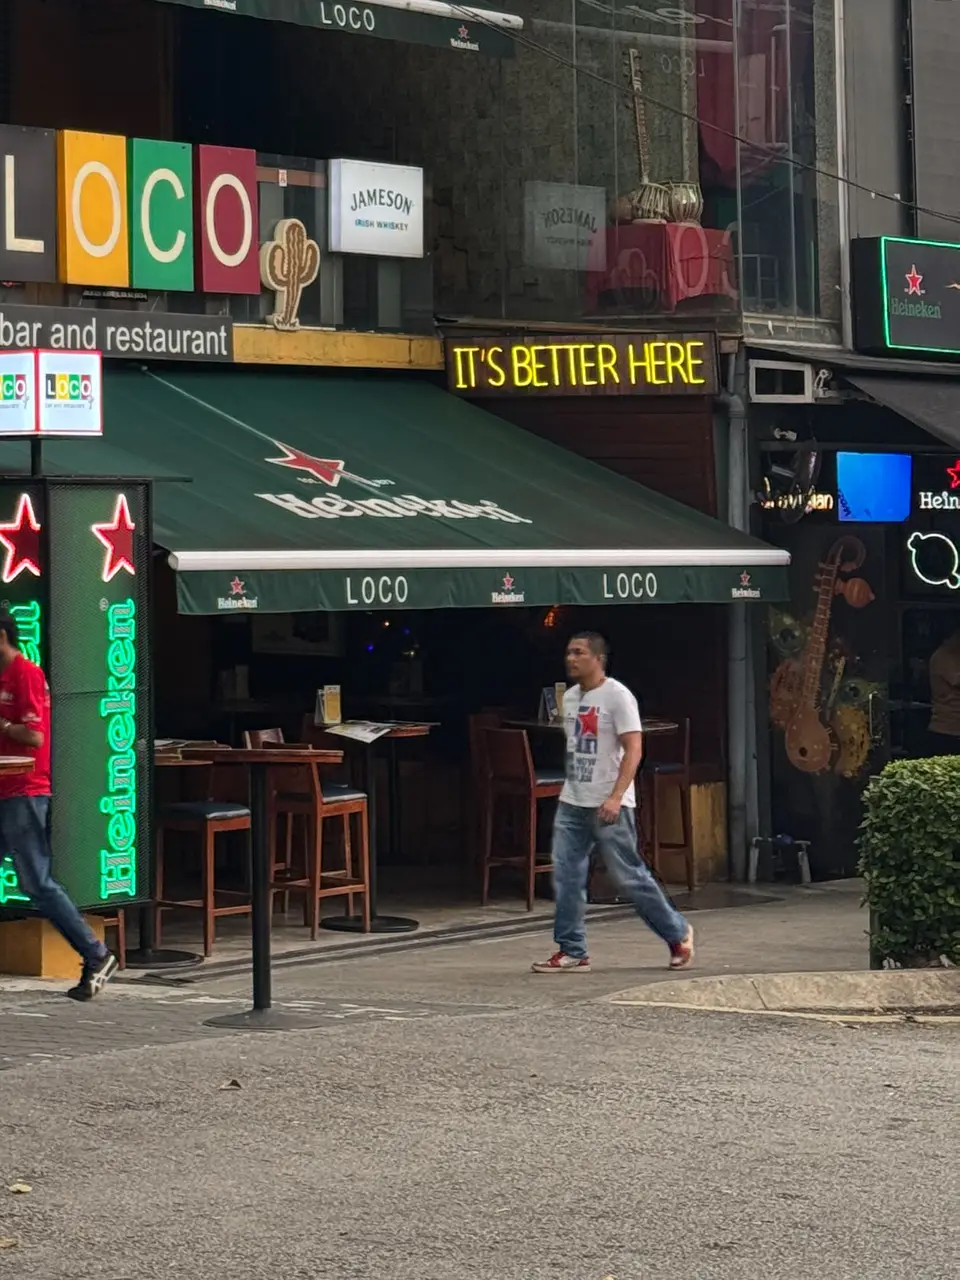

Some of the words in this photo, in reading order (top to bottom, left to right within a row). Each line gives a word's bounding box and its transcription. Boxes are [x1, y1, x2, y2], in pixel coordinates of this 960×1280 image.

[320, 1, 375, 31] LOCO
[4, 154, 253, 267] LOCO
[350, 188, 413, 215] JAMESON
[376, 220, 409, 231] WHISKEY
[891, 298, 942, 319] Heineken
[0, 313, 42, 347] bar
[50, 318, 97, 349] and
[107, 321, 228, 355] restaurant
[453, 347, 506, 388] IT'S
[511, 342, 620, 387] BETTER
[628, 342, 705, 385] HERE
[46, 377, 92, 398] LOCO
[346, 576, 409, 604] LOCO
[492, 590, 525, 603] Heineken
[603, 572, 658, 598] LOCO
[218, 596, 258, 610] Heineken
[100, 598, 136, 900] Heineken
